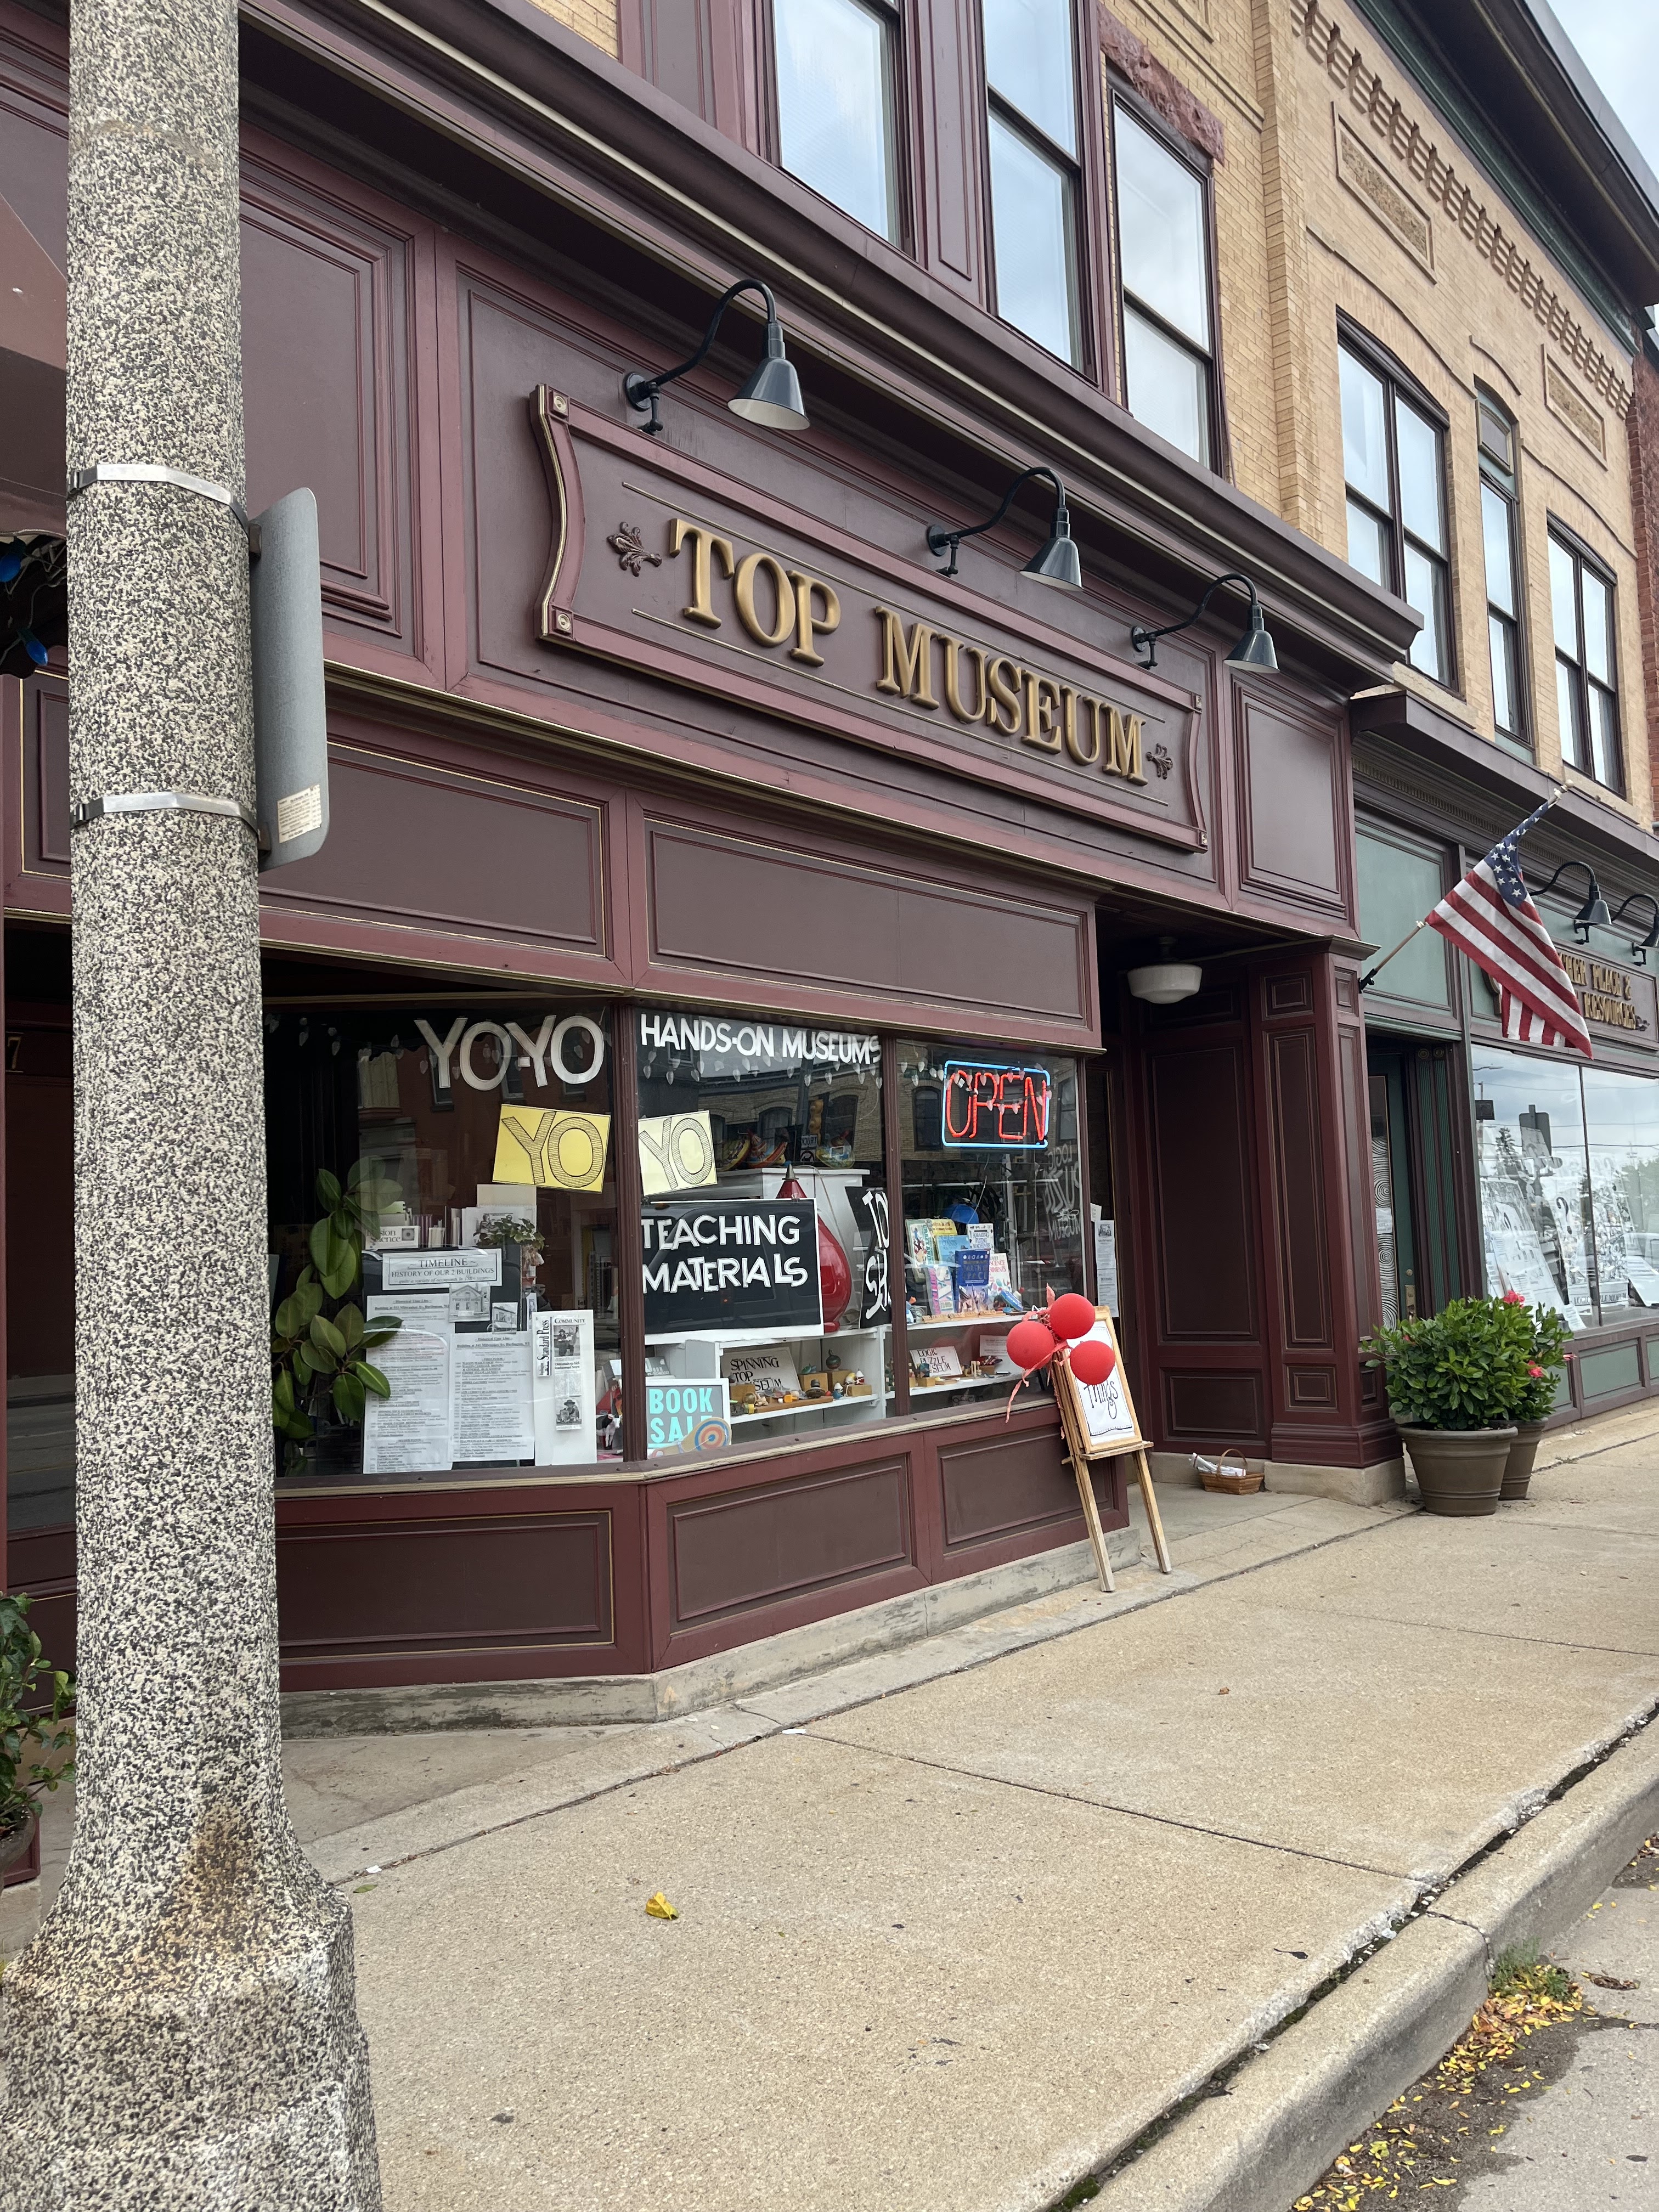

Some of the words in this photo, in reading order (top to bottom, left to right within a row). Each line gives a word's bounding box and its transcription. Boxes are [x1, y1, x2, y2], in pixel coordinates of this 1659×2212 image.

[669, 518, 840, 666] TOP
[875, 606, 1148, 786] MUSEUM
[1590, 964, 1622, 997] PLACE
[1624, 975, 1631, 1000] &
[1583, 992, 1636, 1030] RESOURCES
[641, 1013, 774, 1058] HANDS-ON
[782, 1029, 882, 1064] MUSEUMS
[946, 1070, 1047, 1141] OPEN
[502, 1111, 603, 1187] YO
[639, 1117, 713, 1190] YO
[641, 1215, 800, 1250] TEACHING
[419, 1258, 467, 1268] TIMELINE
[642, 1253, 808, 1294] MATERIALS
[537, 1320, 549, 1335] Press
[537, 1336, 549, 1360] Standard
[917, 1348, 938, 1357] LOGIC
[920, 1356, 946, 1365] PUZZLE
[730, 1356, 779, 1370] SPINNING
[733, 1371, 753, 1382] TOP
[750, 1378, 781, 1391] SEUM
[650, 1388, 713, 1414] BOOK
[650, 1415, 713, 1443] SAL
